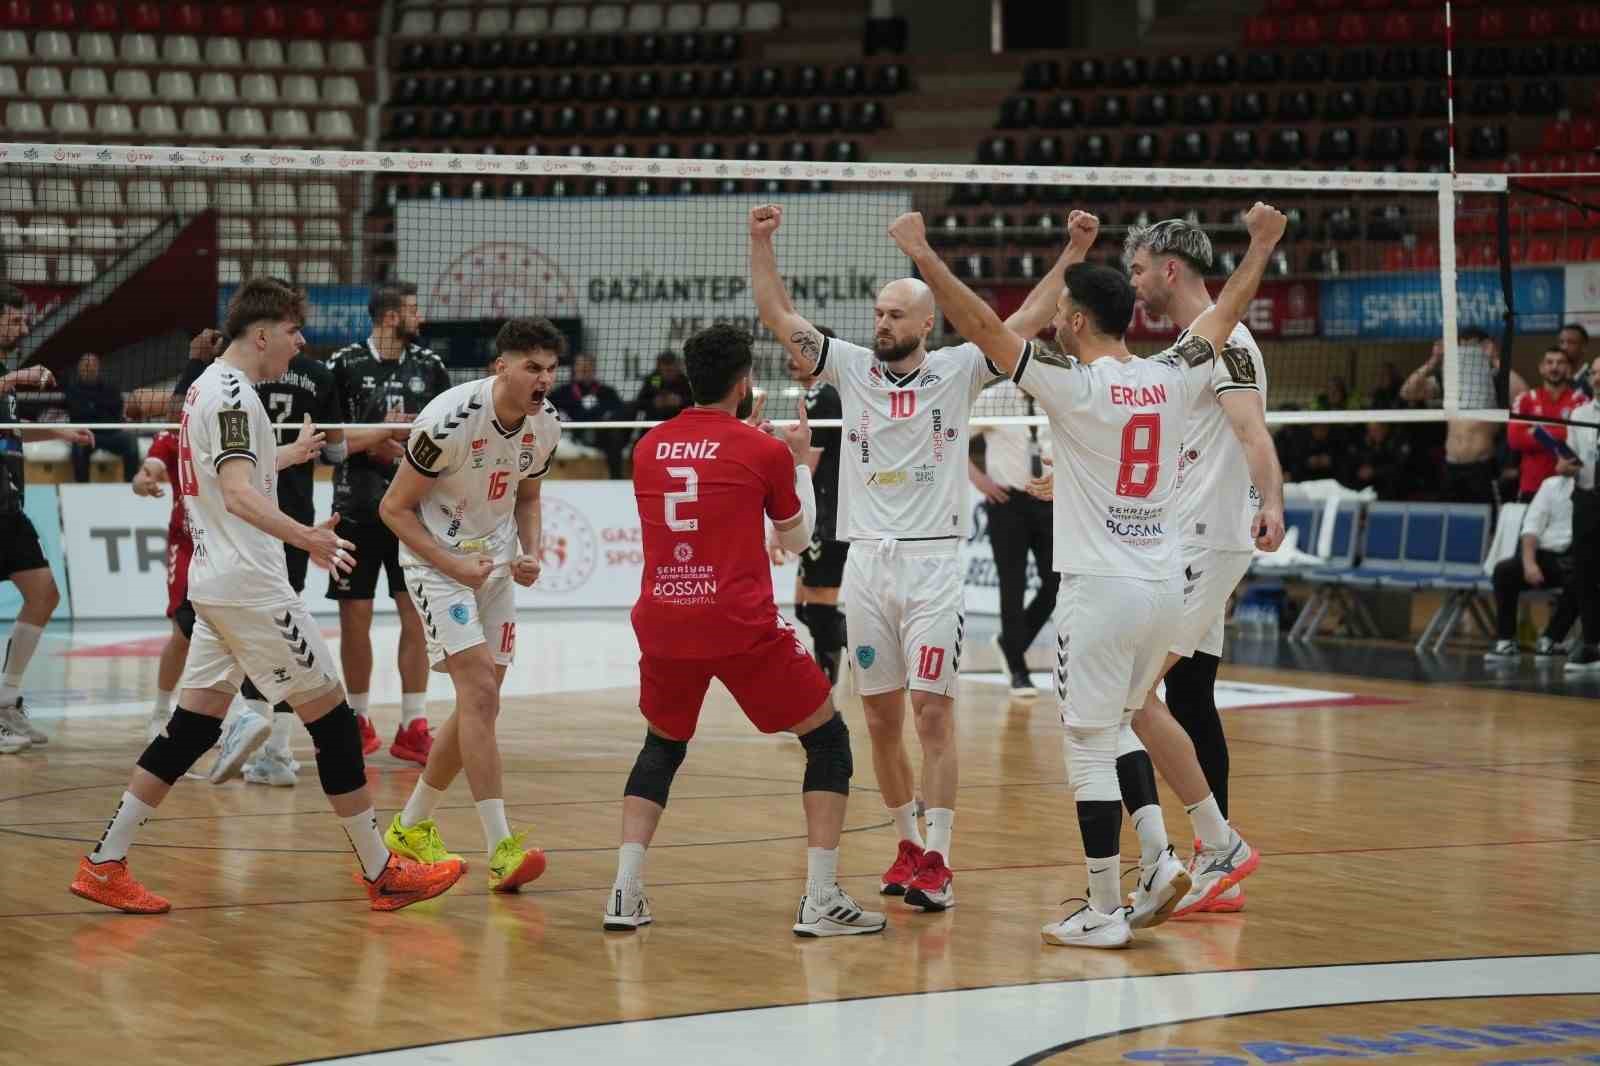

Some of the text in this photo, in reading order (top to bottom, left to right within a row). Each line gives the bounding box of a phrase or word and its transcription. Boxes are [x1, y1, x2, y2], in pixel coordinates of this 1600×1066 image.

[888, 389, 917, 420] 10
[655, 439, 721, 460] DENİZ
[1116, 412, 1161, 498] 8
[487, 471, 511, 502] 16
[664, 466, 699, 532] 2
[1106, 519, 1164, 537] BOSSAN
[653, 580, 717, 597] BOSSAN
[917, 645, 945, 681] 10
